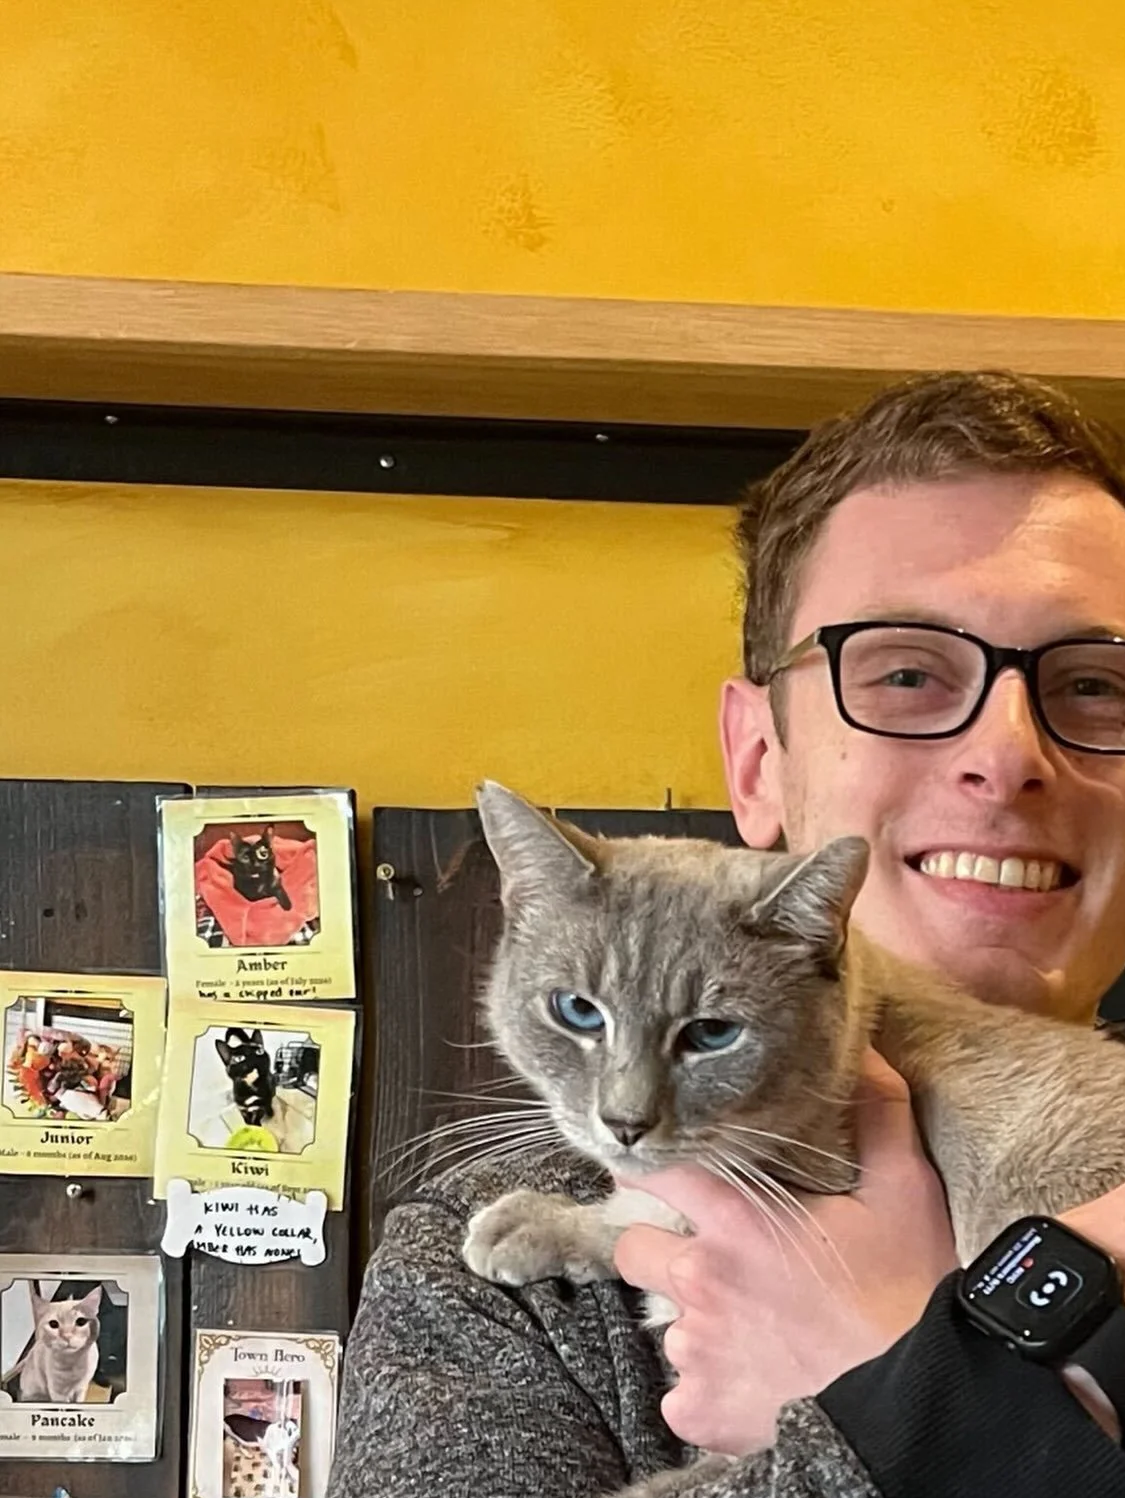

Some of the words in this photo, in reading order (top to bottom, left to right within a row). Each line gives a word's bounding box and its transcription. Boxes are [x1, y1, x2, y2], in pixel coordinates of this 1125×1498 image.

[236, 958, 288, 974] Amber
[40, 1131, 94, 1144] Junior
[231, 1162, 269, 1176] Kiwi
[203, 1202, 240, 1214] KIWI
[245, 1204, 279, 1217] HAS
[214, 1223, 265, 1237] YELLOW
[229, 1347, 269, 1362] Town
[273, 1349, 306, 1362] Hero
[31, 1414, 95, 1427] Pancake
